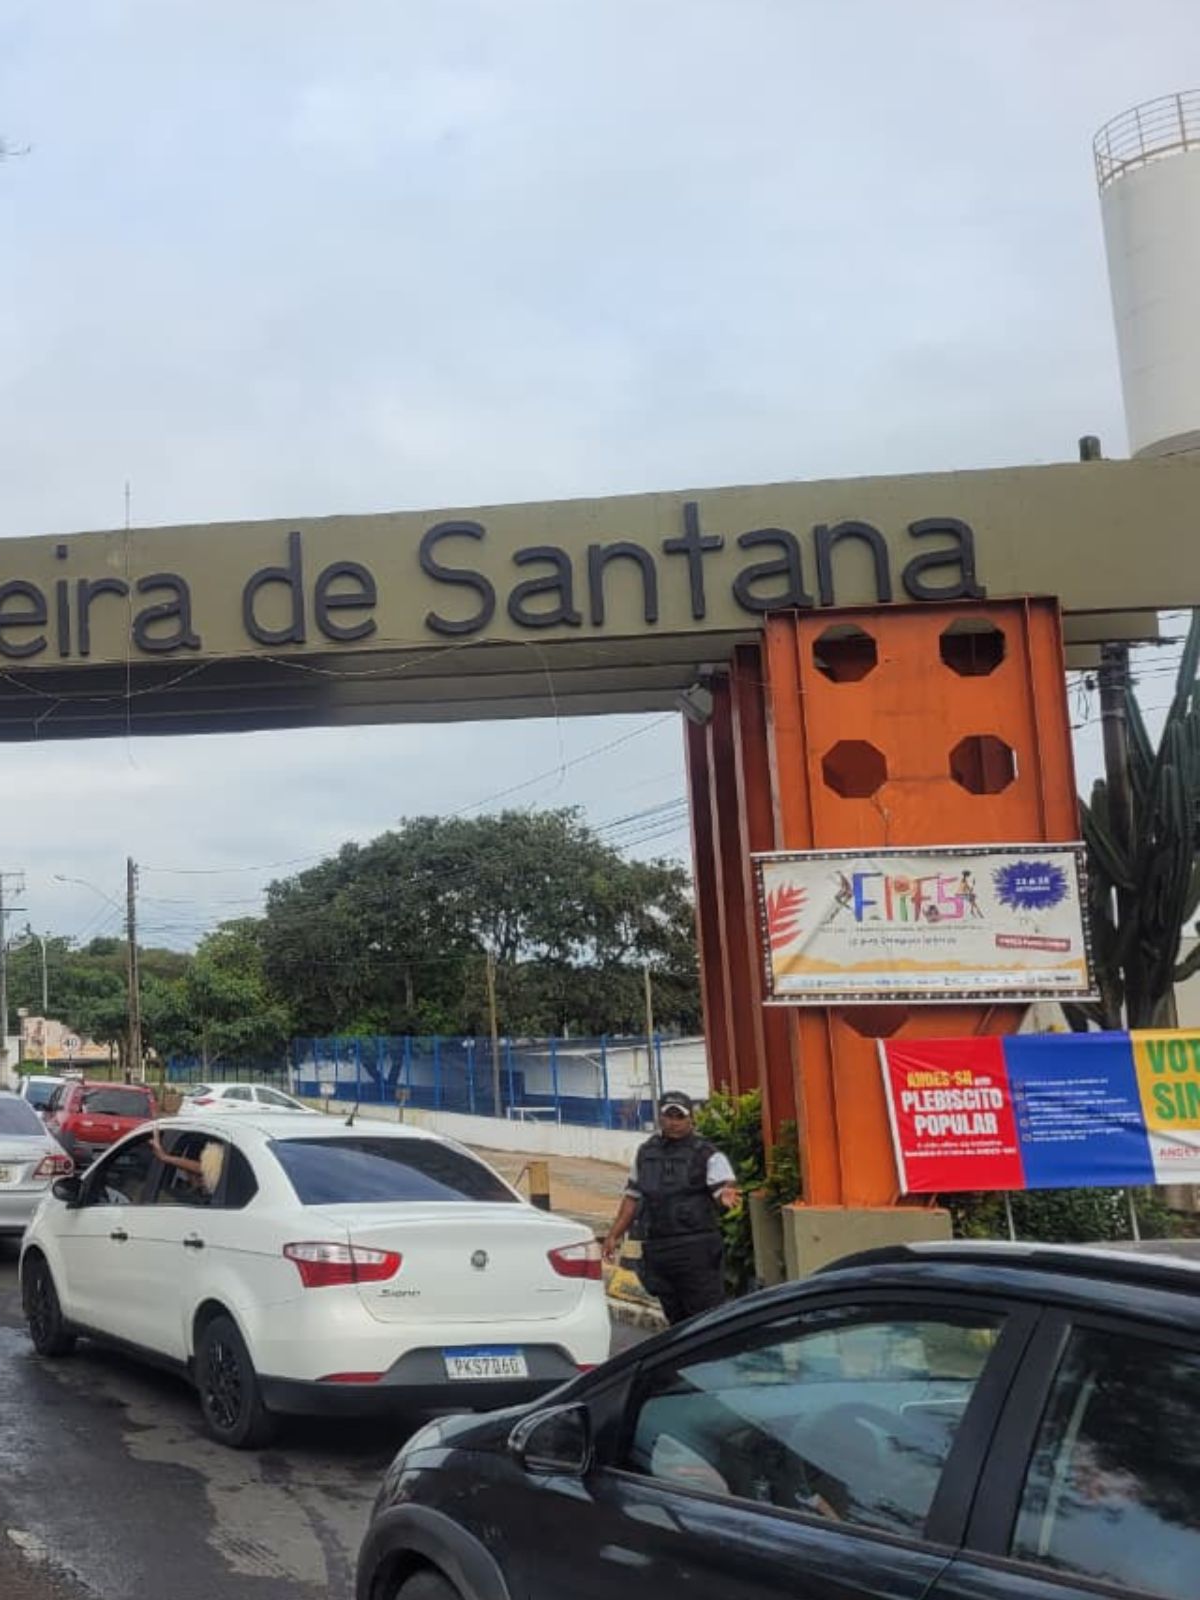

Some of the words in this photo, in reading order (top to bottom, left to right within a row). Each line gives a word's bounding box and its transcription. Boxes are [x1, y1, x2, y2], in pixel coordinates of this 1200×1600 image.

[242, 531, 378, 646] de
[418, 501, 988, 636] Santana
[901, 1088, 1004, 1113] PLEBISCITO
[914, 1112, 999, 1137] POPULAR
